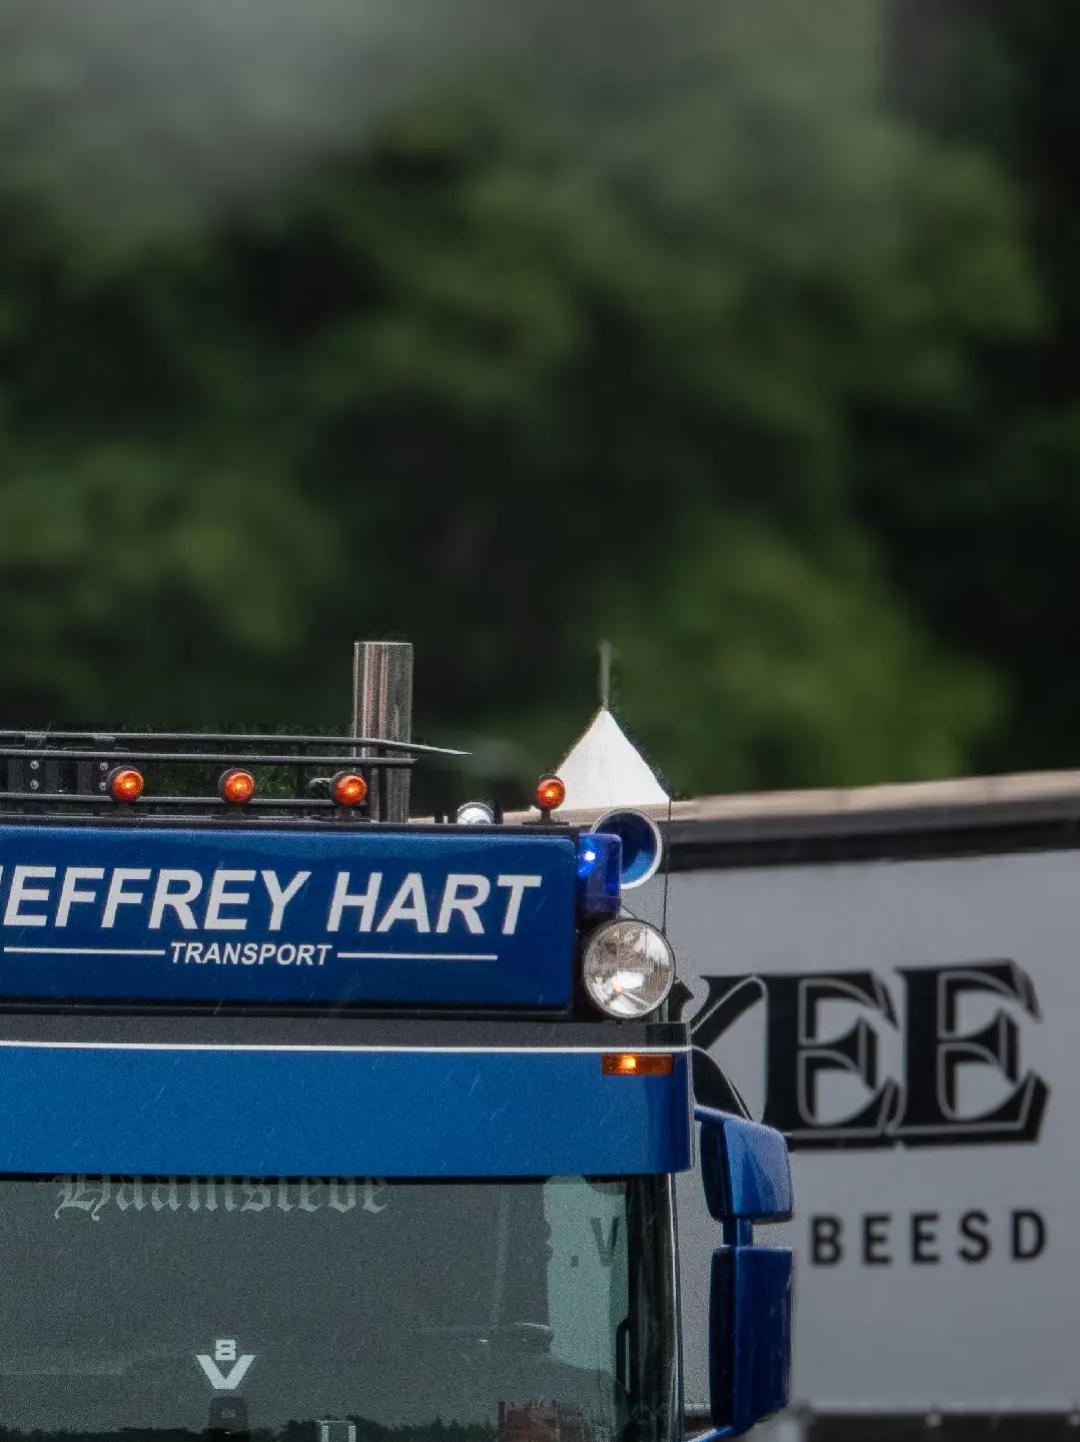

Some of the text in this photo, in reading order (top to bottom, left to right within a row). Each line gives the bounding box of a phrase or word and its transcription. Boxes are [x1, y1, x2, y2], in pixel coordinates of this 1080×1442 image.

[327, 871, 542, 936] HART
[170, 941, 333, 967] TRANSPORT
[810, 1208, 1047, 1267] BEESD
